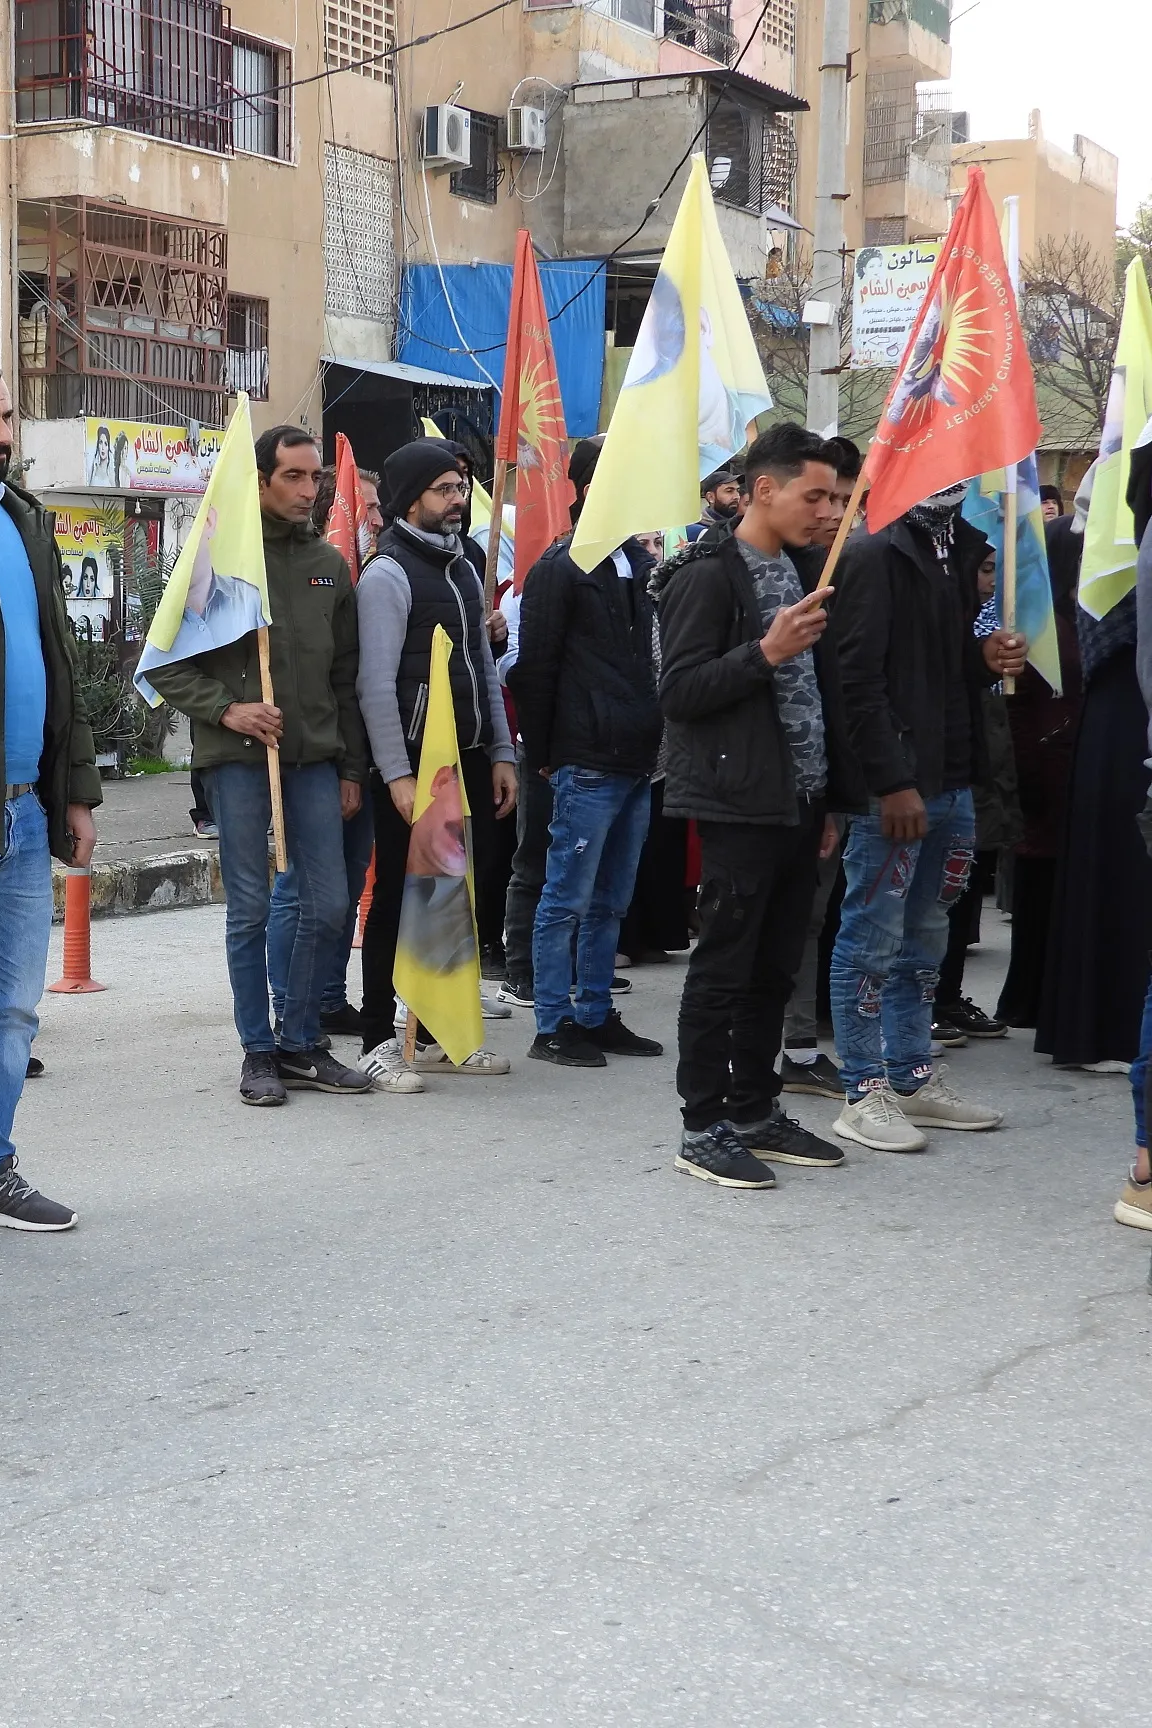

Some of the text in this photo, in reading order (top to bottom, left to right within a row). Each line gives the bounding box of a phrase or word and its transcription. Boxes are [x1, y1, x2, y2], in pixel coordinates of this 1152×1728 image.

[887, 249, 935, 270] صالون
[859, 276, 930, 303] اسمين الشام
[134, 428, 163, 460] الشام
[200, 437, 221, 458] الون
